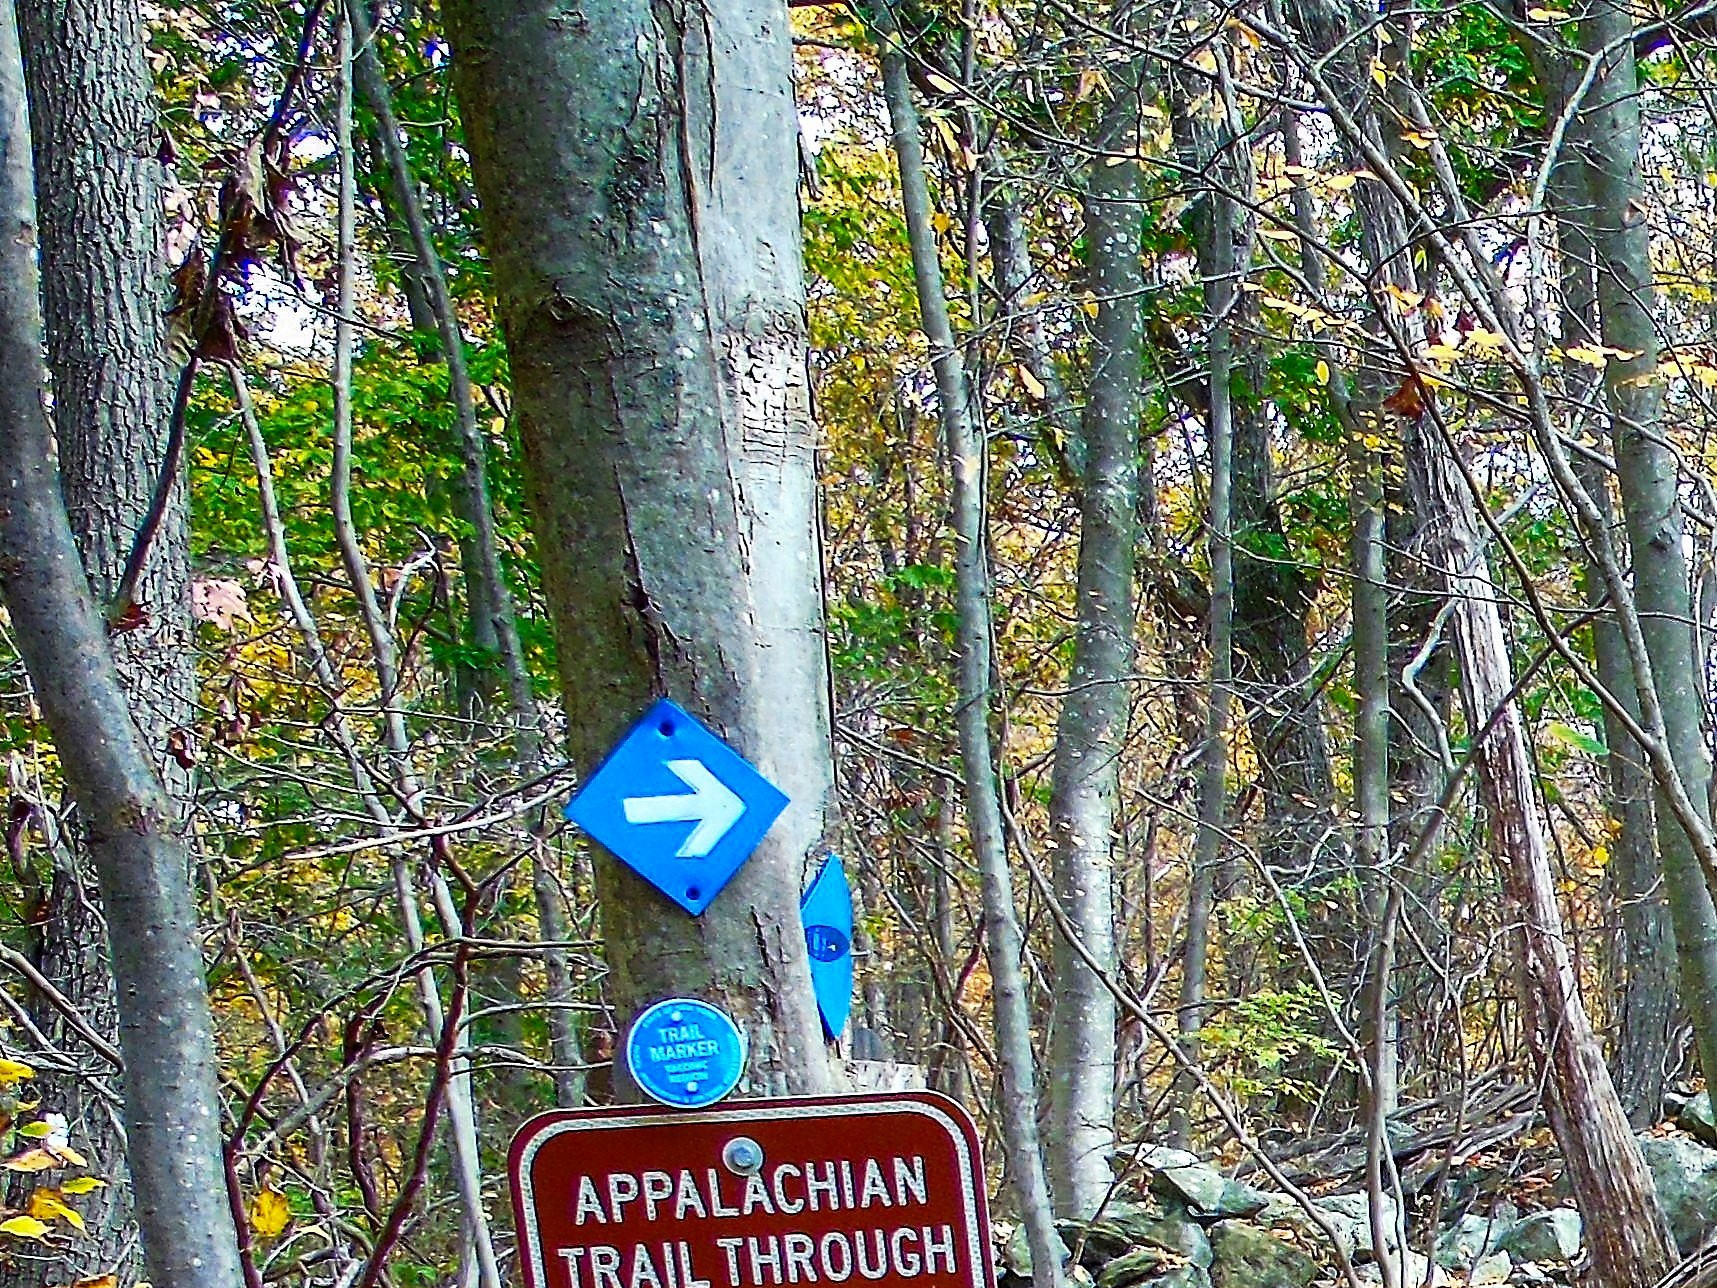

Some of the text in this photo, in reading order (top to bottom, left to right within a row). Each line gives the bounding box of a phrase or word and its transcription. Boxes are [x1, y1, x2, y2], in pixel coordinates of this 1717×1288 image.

[649, 1039, 720, 1063] MARKER
[658, 1023, 705, 1044] TRAIL
[574, 1155, 929, 1226] APPALACHIAN
[716, 1224, 957, 1287] THROUGH
